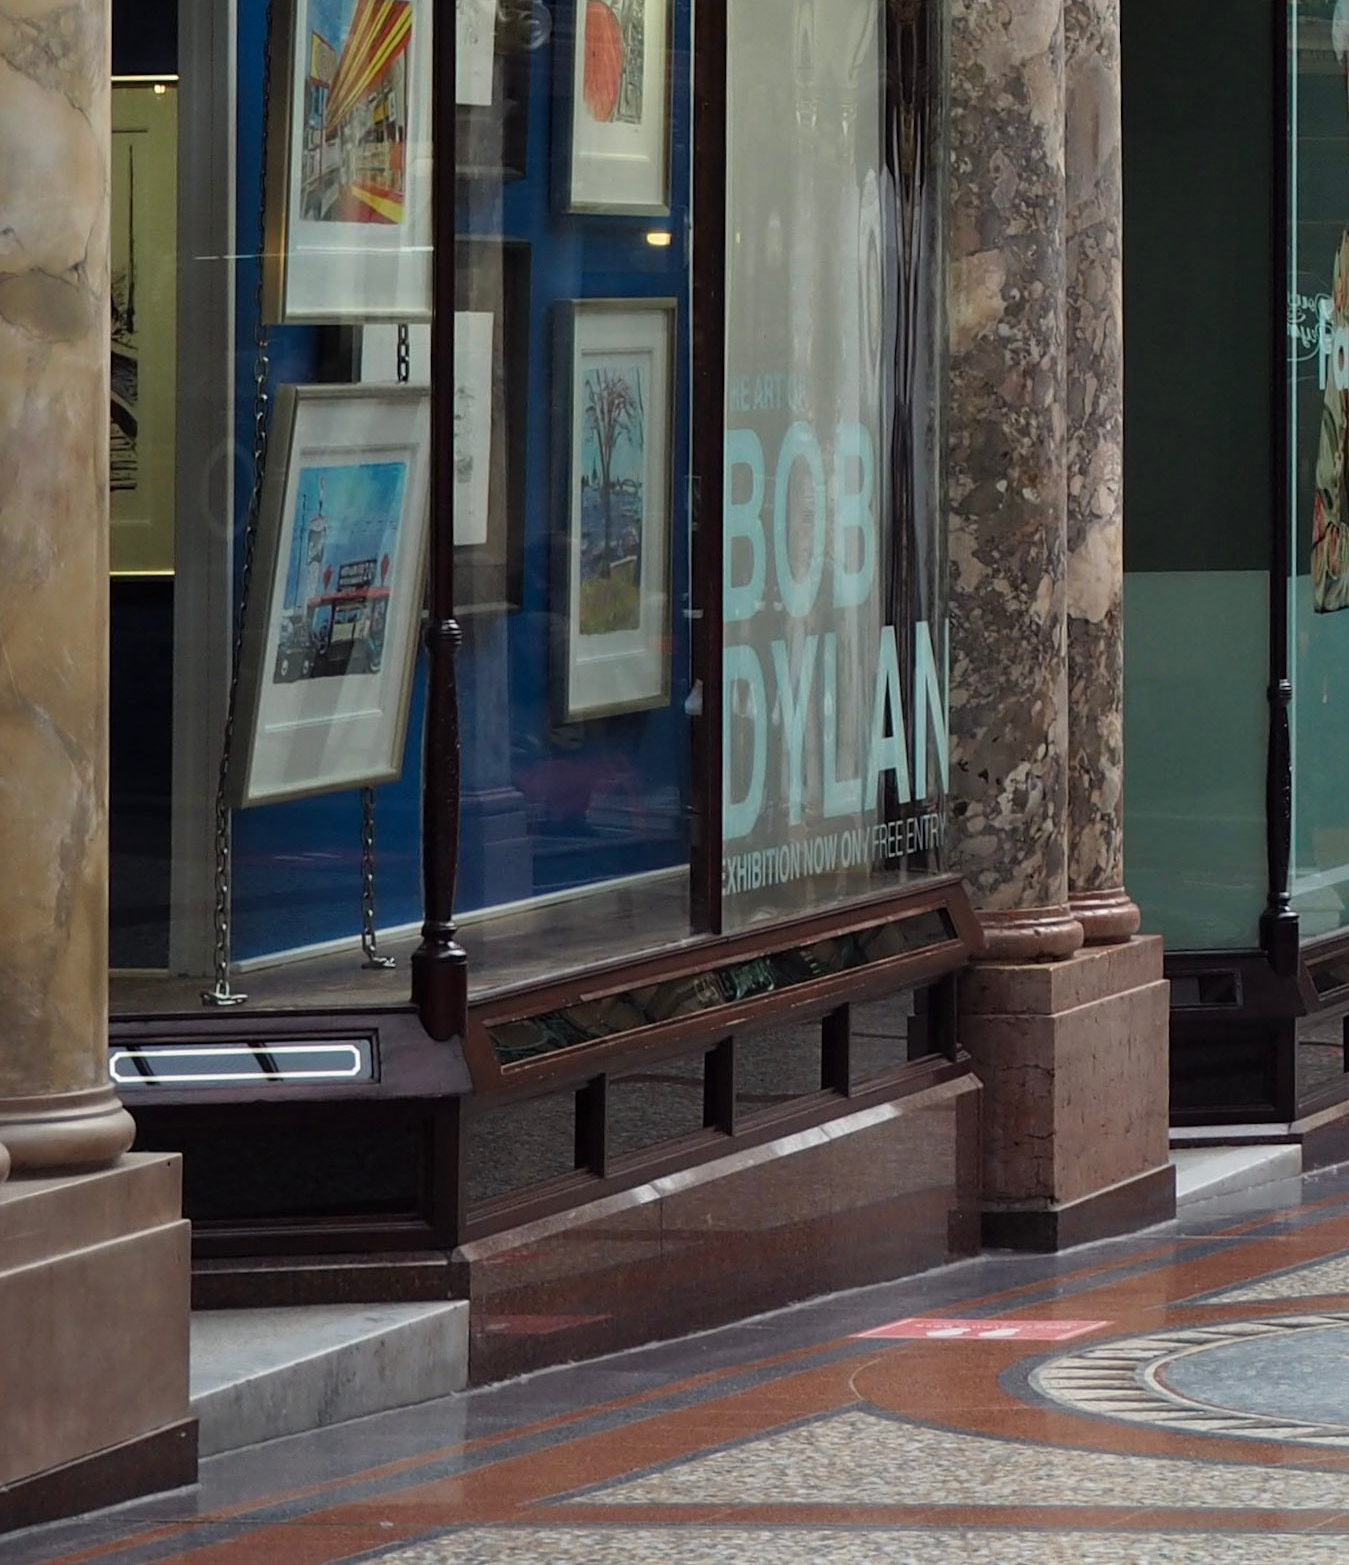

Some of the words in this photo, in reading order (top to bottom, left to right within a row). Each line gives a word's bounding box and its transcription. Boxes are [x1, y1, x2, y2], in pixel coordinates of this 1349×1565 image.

[728, 377, 749, 410] HE
[723, 420, 875, 622] BOB
[722, 617, 949, 841] DYLAN
[803, 834, 837, 876] NOW
[841, 832, 861, 869] ON
[871, 819, 903, 860] FREE
[906, 811, 948, 854] ENTRY
